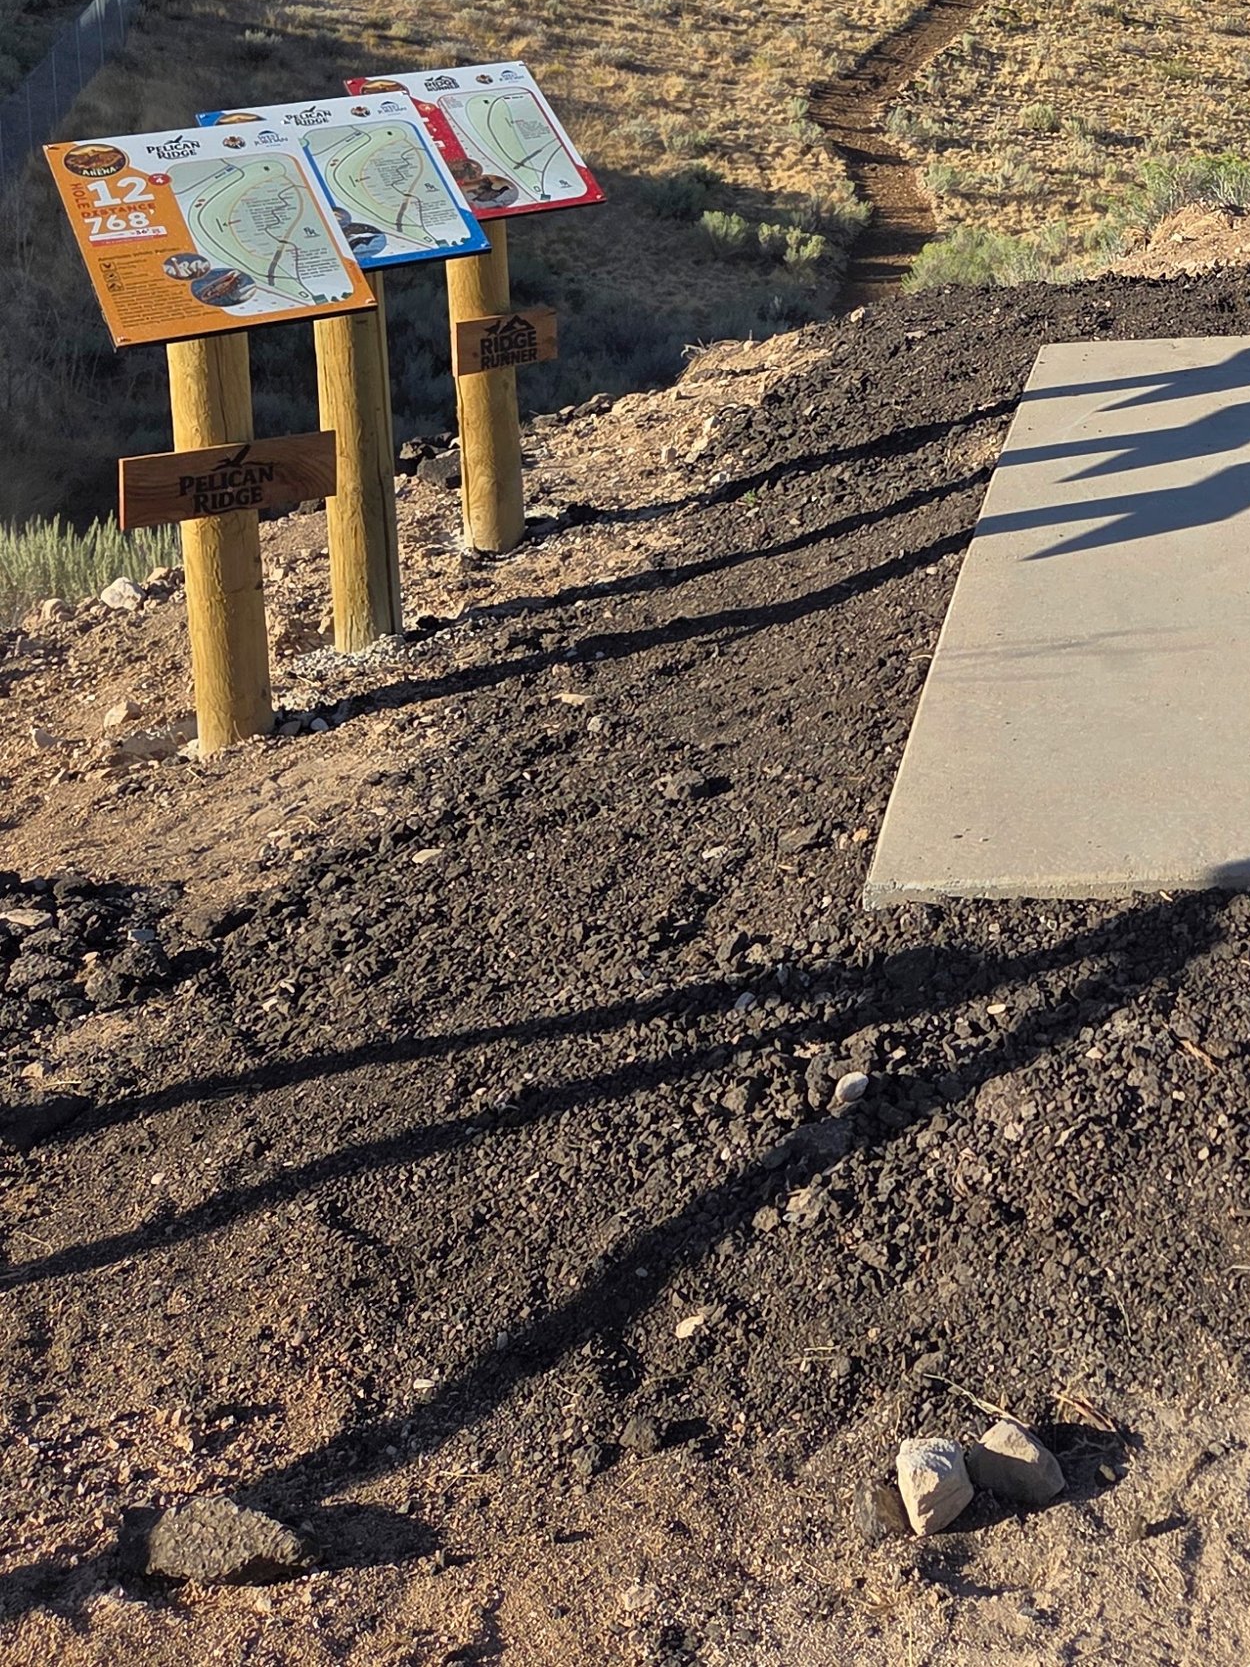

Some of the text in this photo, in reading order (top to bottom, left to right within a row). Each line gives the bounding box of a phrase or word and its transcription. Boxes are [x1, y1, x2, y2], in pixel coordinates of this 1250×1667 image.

[284, 110, 332, 121] PELICAN
[295, 117, 329, 126] RIDGE
[146, 141, 201, 154] PELICAN
[157, 149, 198, 160] RIDGE
[82, 166, 117, 177] ARENA
[71, 182, 90, 210] HOLE
[87, 176, 155, 208] 12
[81, 203, 157, 219] DISTANCE
[480, 331, 537, 356] RIDGE
[480, 348, 538, 370] RUNNER
[179, 465, 274, 497] PELICAN
[193, 485, 263, 514] RIDGE
